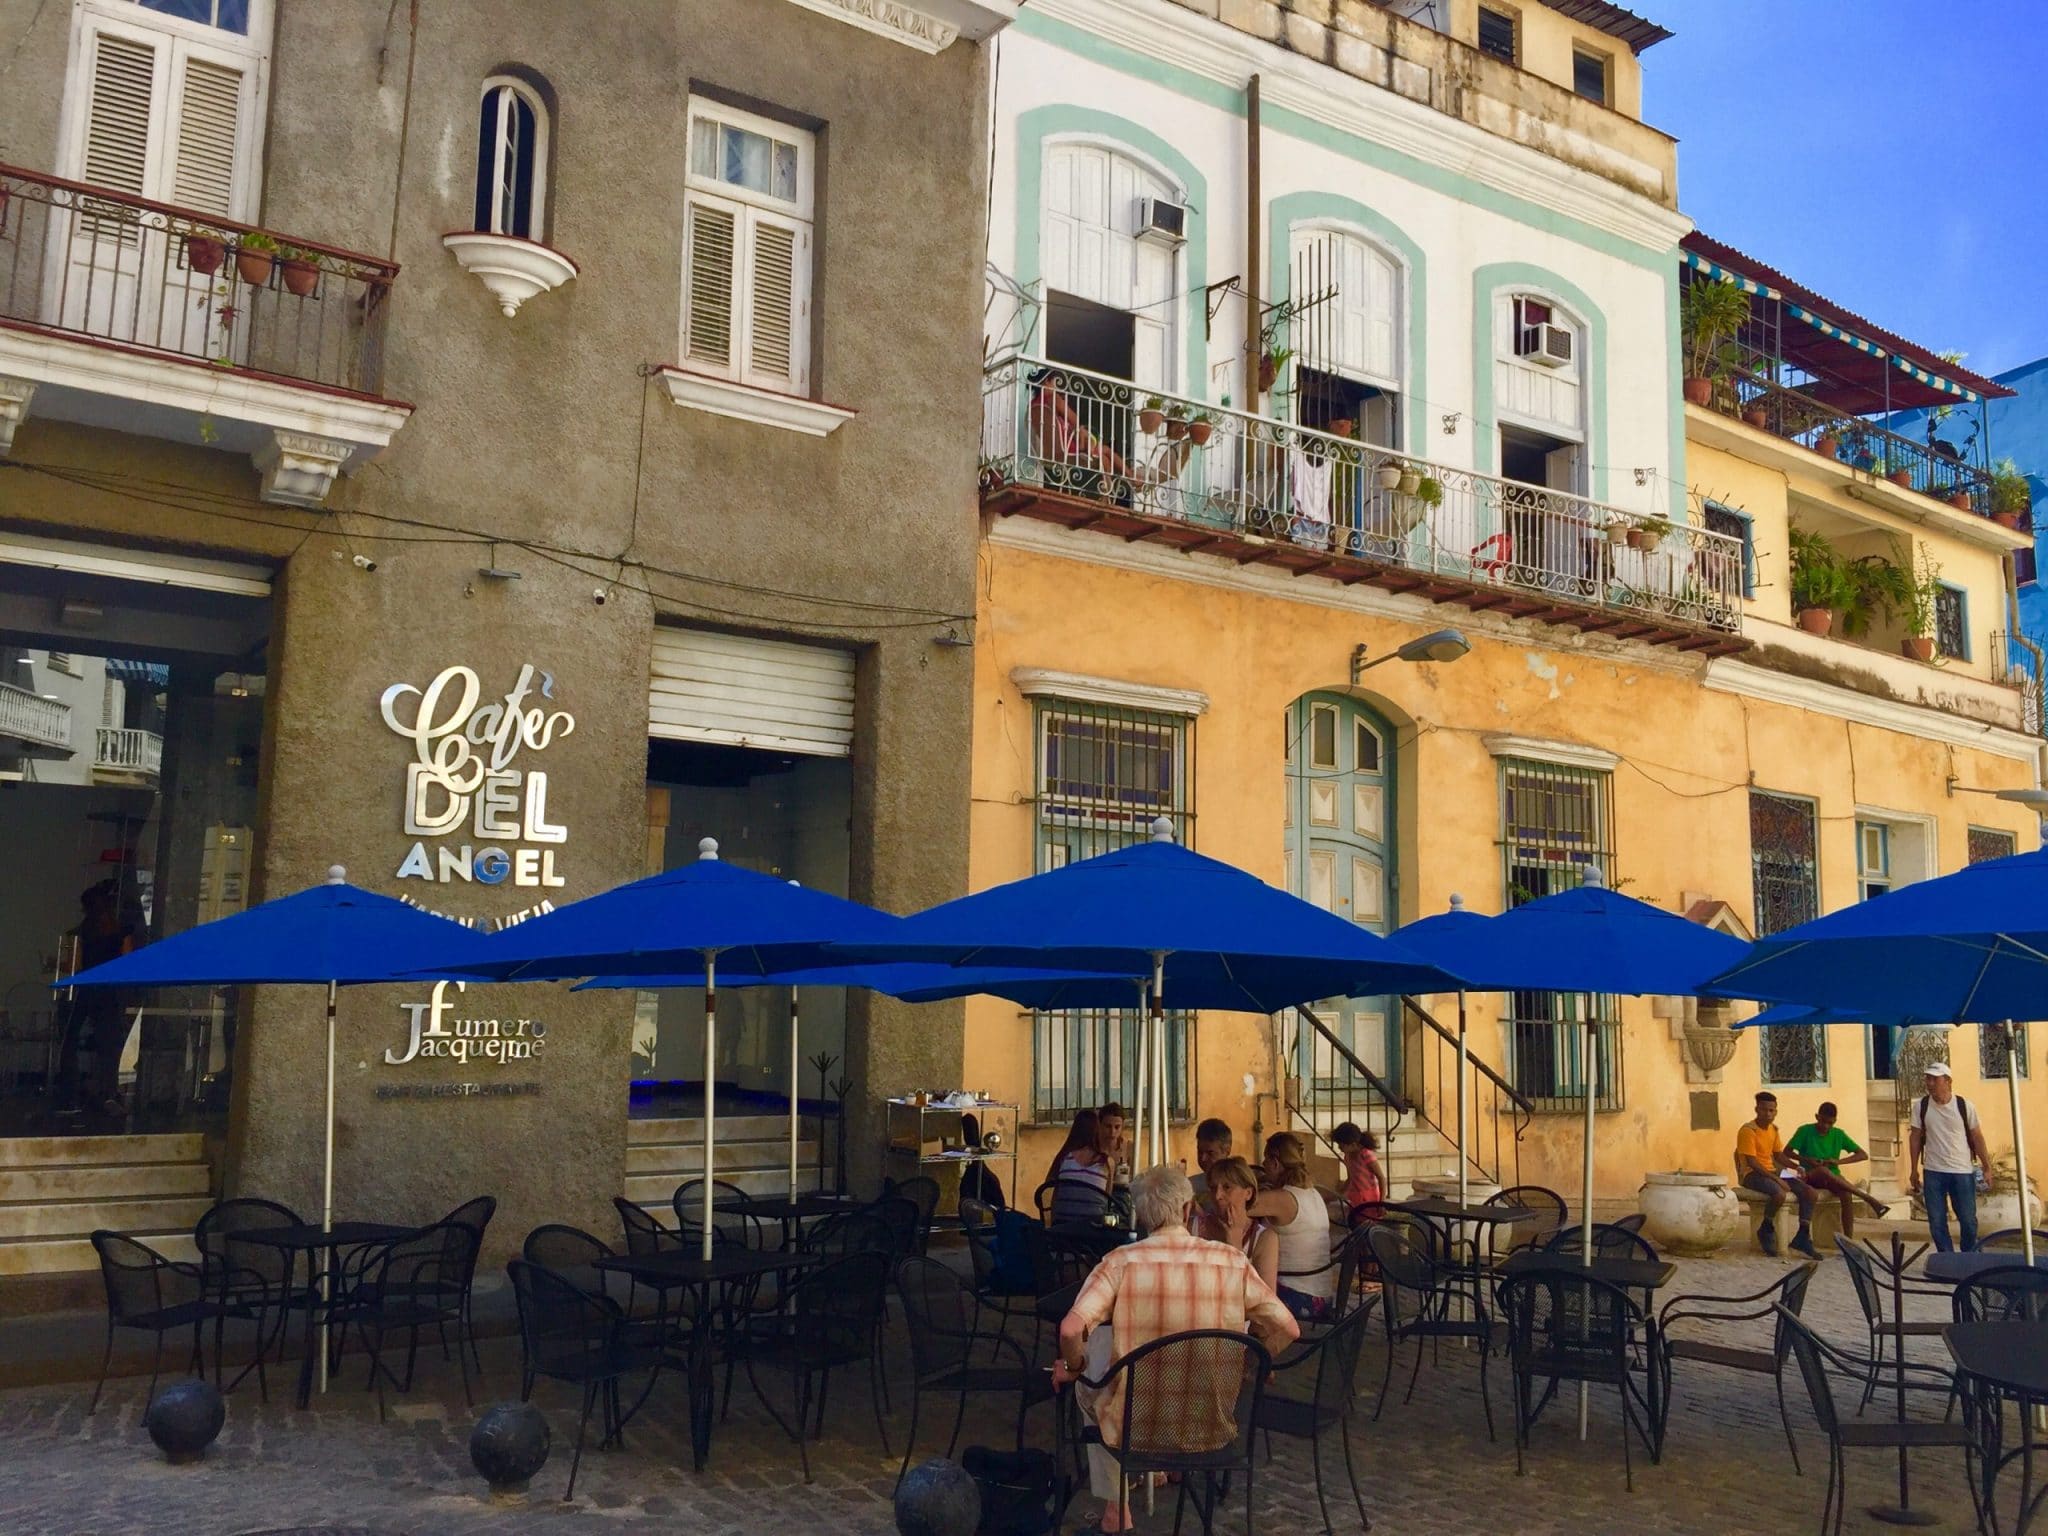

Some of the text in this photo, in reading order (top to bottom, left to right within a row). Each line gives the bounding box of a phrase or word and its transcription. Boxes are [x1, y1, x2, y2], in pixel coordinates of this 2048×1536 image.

[404, 763, 568, 843] DEL
[396, 842, 566, 888] ANGEL
[385, 1003, 546, 1065] Jacqueline
